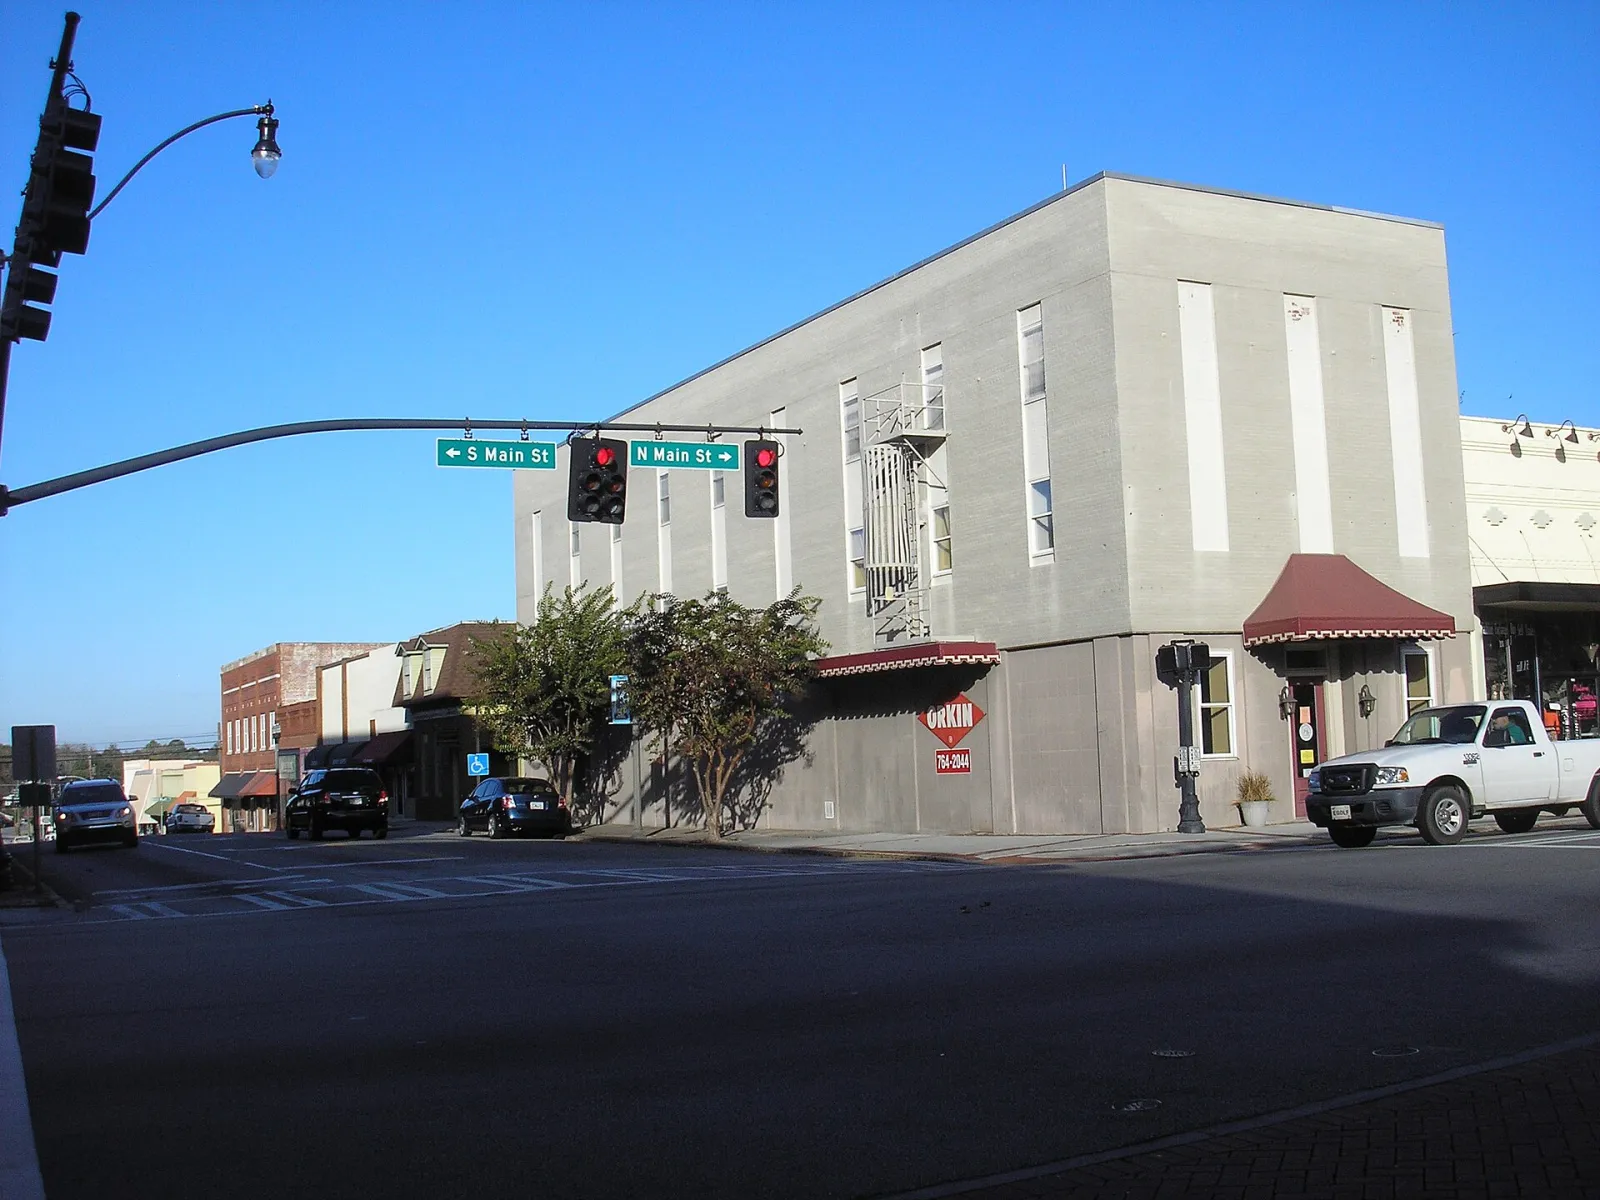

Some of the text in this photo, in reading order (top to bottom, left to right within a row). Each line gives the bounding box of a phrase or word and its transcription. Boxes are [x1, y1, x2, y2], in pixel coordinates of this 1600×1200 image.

[467, 446, 549, 463] S Main St
[637, 446, 712, 463] N Main St
[926, 703, 973, 729] ORKIN
[937, 754, 969, 769] 764-2044
